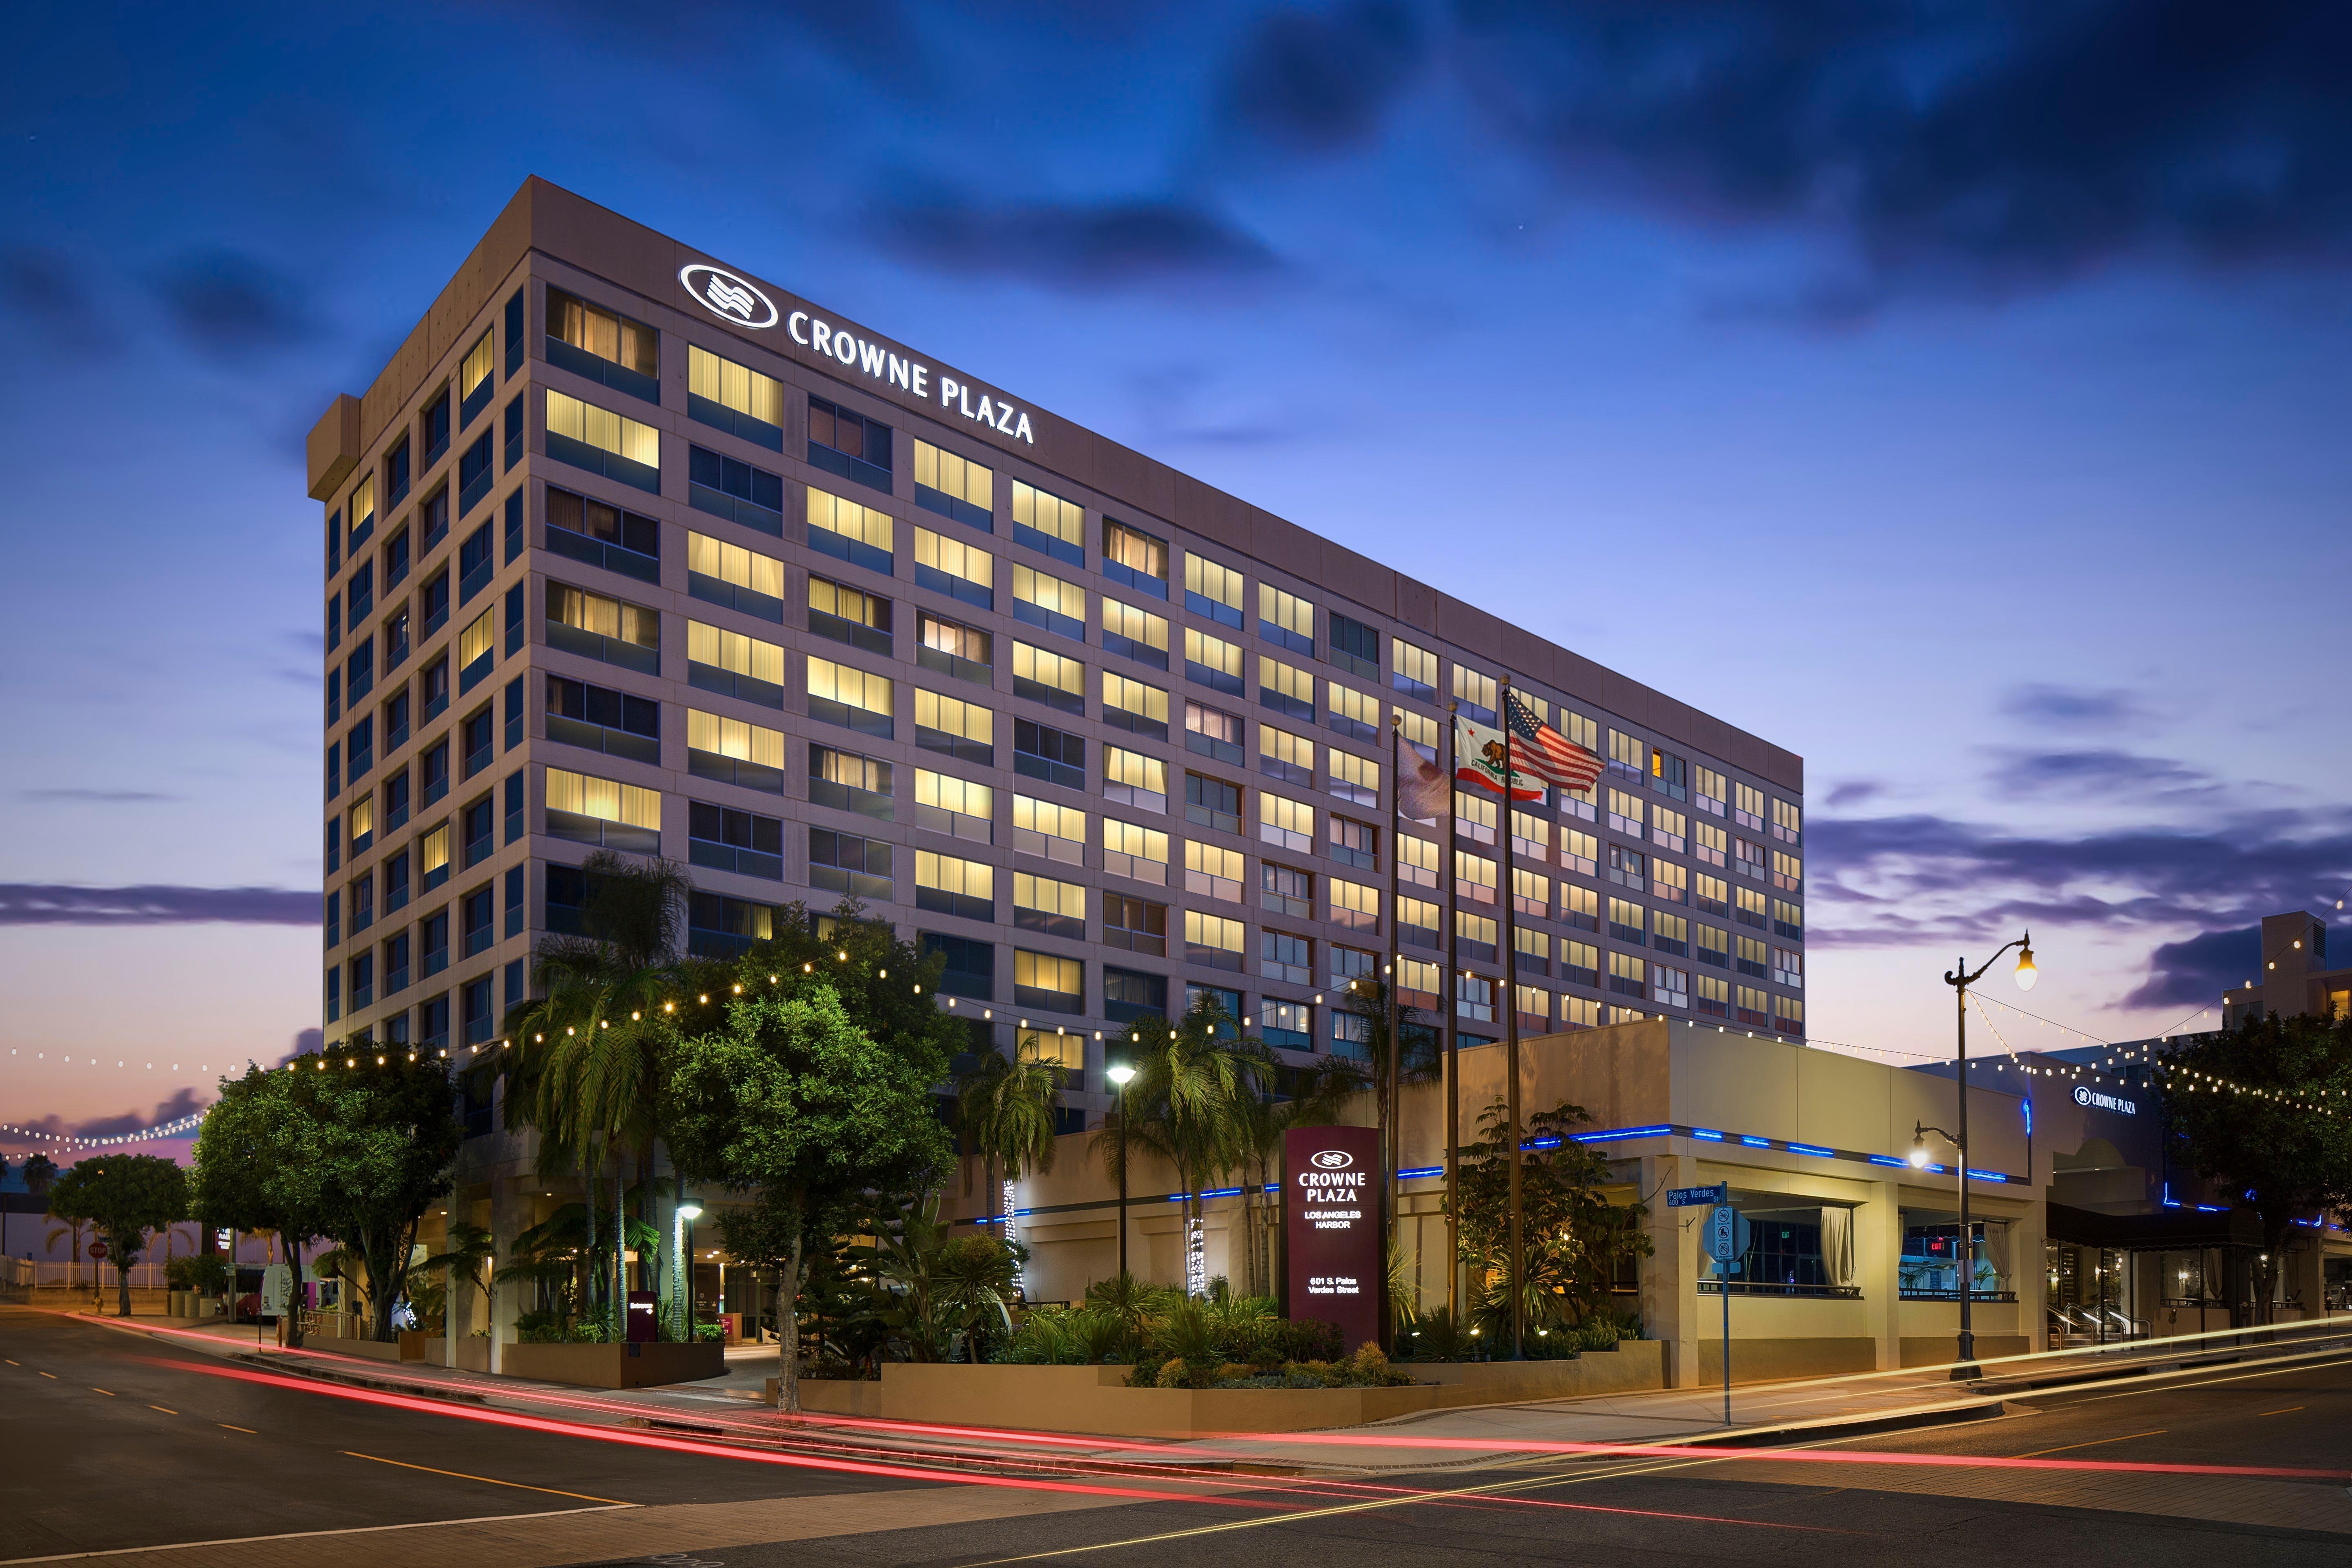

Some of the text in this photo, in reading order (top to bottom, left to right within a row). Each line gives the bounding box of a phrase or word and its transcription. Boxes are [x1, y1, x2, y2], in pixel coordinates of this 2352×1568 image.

[788, 312, 1033, 444] CROWNE PLAZA
[1471, 760, 1497, 781] CALIFORNIA
[2092, 1092, 2136, 1115] CROWNE PLAZA
[1299, 1173, 1365, 1202] CROWNE PLAZA
[1669, 1189, 1714, 1200] Palos Verdes
[1305, 1211, 1361, 1219] LOS ANGELES
